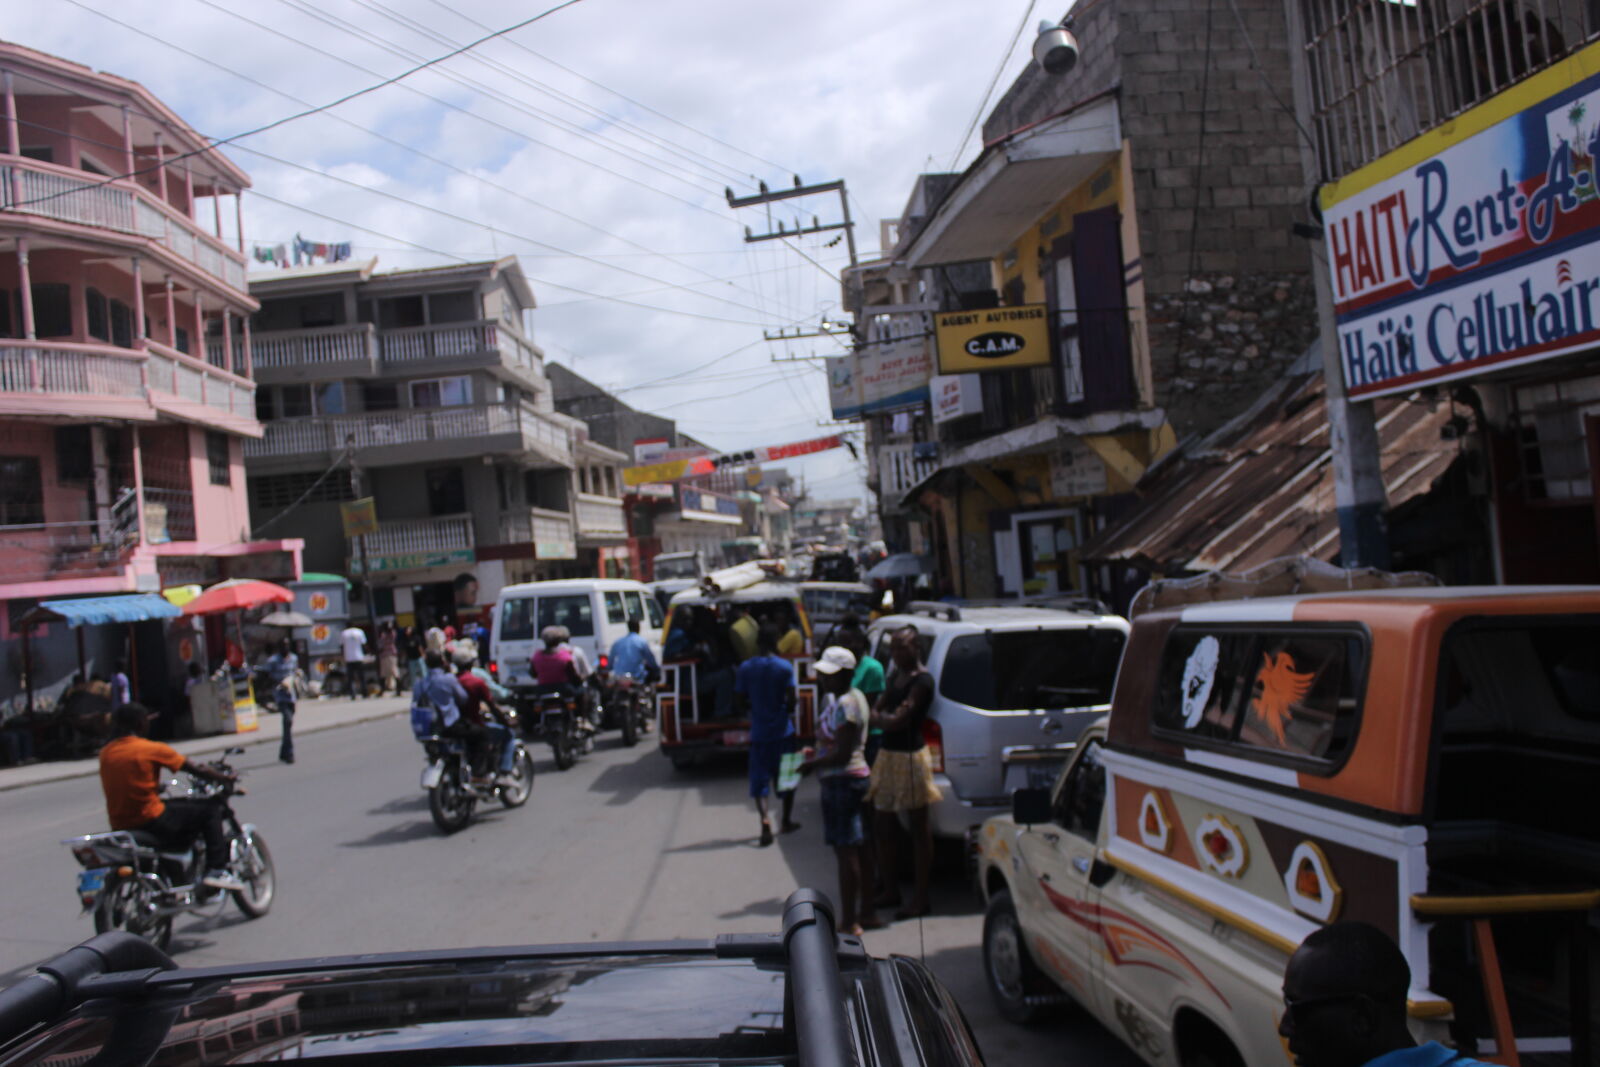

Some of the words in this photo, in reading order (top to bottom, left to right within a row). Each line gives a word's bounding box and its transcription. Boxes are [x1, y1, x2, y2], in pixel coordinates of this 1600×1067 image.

[1330, 189, 1417, 298] HAITI
[942, 314, 980, 327] AGENT
[986, 309, 1044, 323] AUTORISE
[967, 338, 1022, 354] C.A.M.
